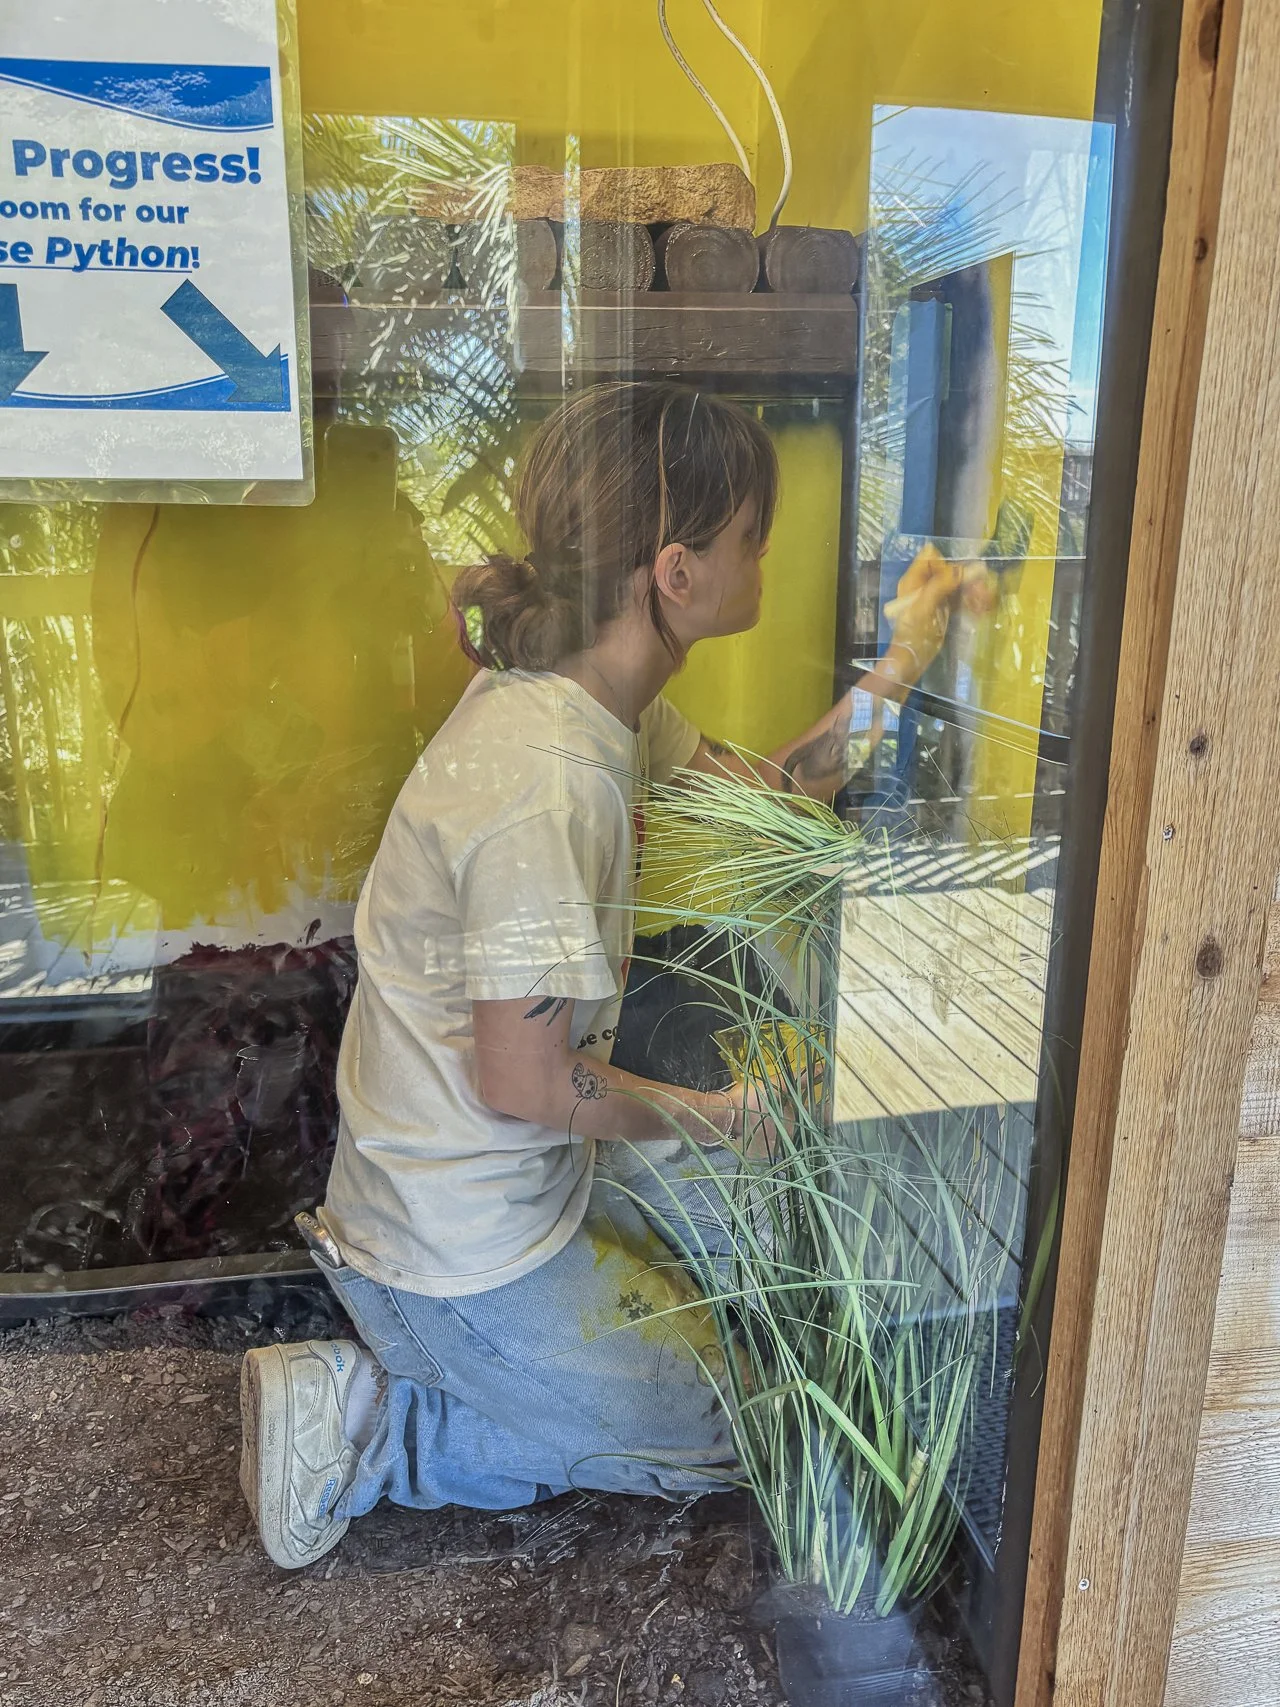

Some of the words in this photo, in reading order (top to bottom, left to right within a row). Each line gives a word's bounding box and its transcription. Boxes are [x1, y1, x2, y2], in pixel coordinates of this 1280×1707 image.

[12, 139, 262, 190] Progress!
[0, 200, 70, 220] oom
[79, 197, 126, 223] for
[136, 204, 189, 224] our
[46, 236, 200, 273] Python!
